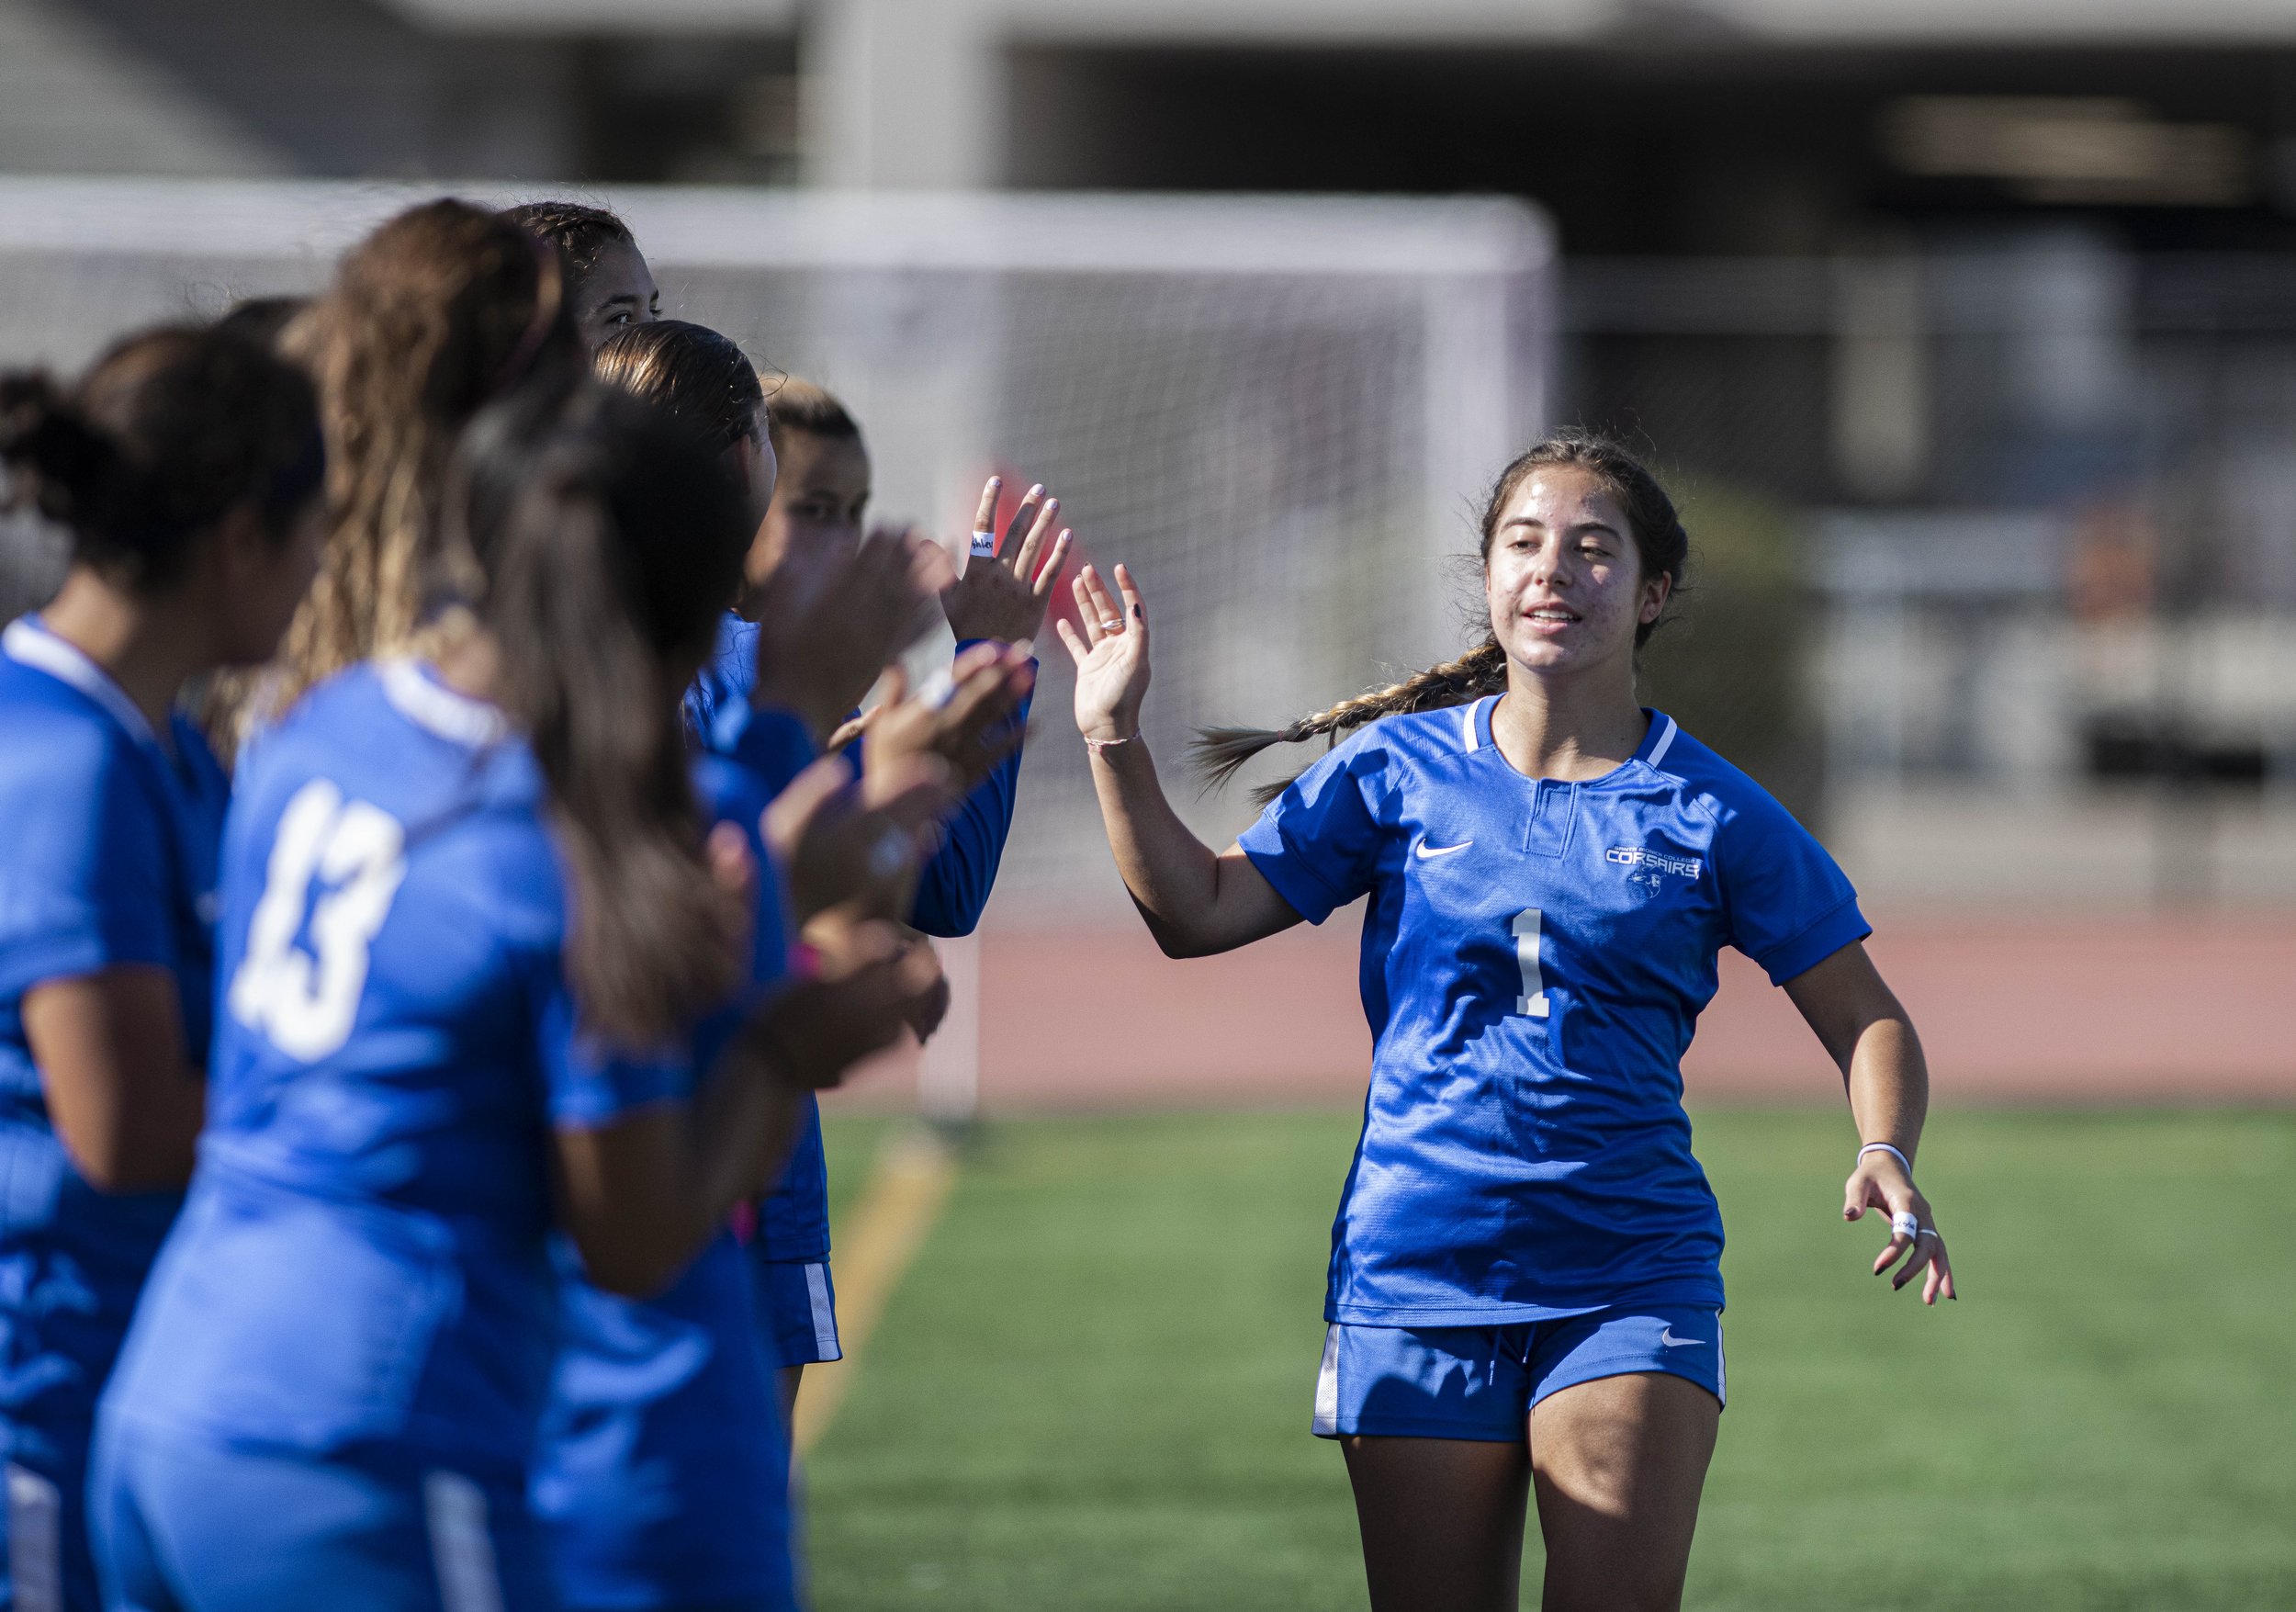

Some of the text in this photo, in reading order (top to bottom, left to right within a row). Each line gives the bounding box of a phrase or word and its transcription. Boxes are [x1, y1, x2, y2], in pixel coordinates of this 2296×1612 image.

[1605, 849, 1699, 878] CORSAIRS
[231, 778, 407, 1062] 13
[1512, 907, 1549, 1017] 1
